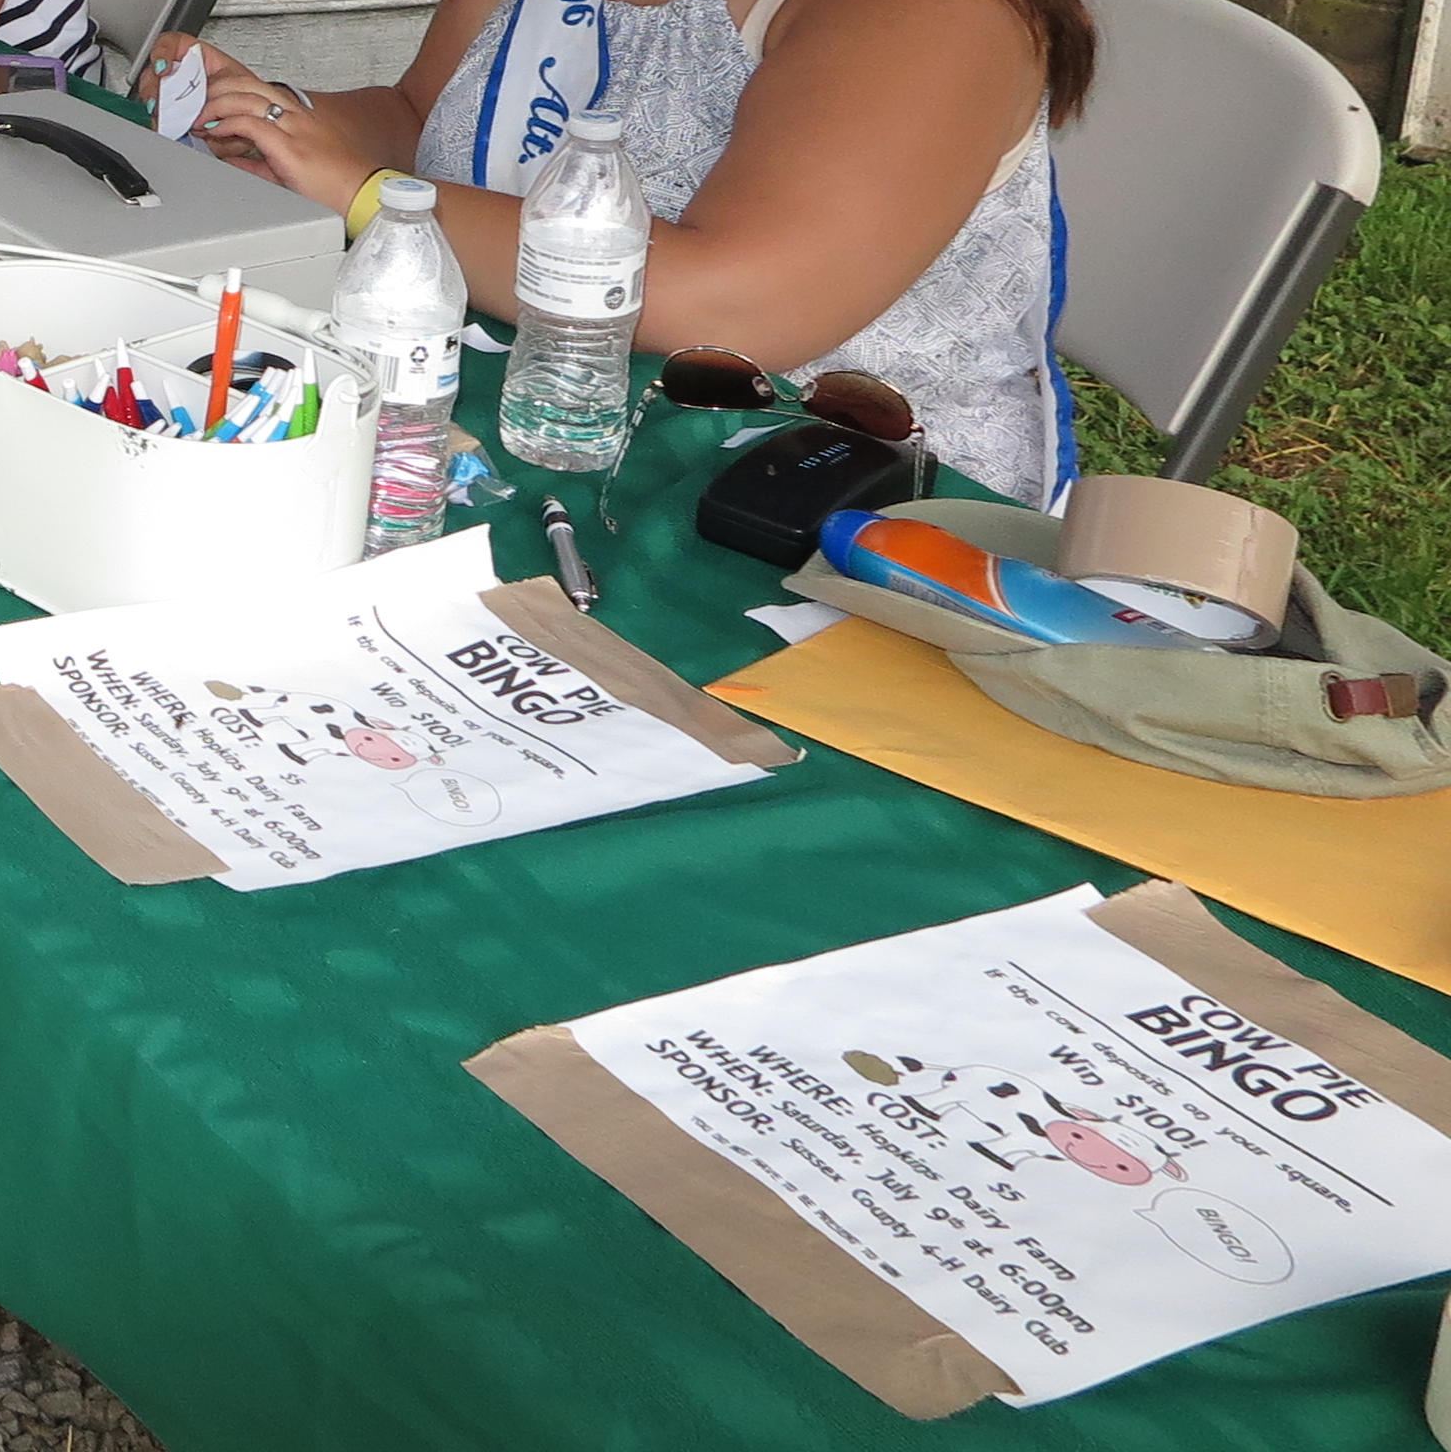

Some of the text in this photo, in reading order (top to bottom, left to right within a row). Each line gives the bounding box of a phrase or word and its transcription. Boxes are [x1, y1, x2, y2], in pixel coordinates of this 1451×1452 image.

[52, 655, 130, 738] SPONSOR:
[86, 648, 140, 710] WHEN:
[370, 681, 472, 748] Win $100!
[445, 639, 586, 725] BINGO
[495, 634, 627, 717] COW PIE
[194, 727, 246, 772] Hopkins
[244, 775, 285, 803] Dairy
[209, 706, 263, 748] COST:
[440, 778, 474, 813] BINGO!
[1124, 1003, 1339, 1122] BINGO
[1180, 994, 1386, 1110] COW PIE
[1006, 983, 1039, 1007] the
[1044, 1009, 1088, 1036] cow
[1092, 1041, 1174, 1097] deposits
[1182, 1102, 1212, 1121] on
[1215, 1125, 1272, 1158] your
[1275, 1161, 1354, 1214] square.
[1047, 1044, 1208, 1151] Win $100!
[644, 1039, 777, 1136] SPONSOR:
[780, 1137, 847, 1184] Sussex
[851, 1188, 917, 1240] County
[918, 1243, 967, 1272] 4-H
[962, 1273, 1020, 1316] Dairy
[685, 1029, 775, 1097] WHEN:
[866, 1167, 921, 1202] July
[963, 1238, 995, 1259] at
[997, 1262, 1096, 1334] 6:00pm
[747, 1044, 1077, 1281] WHERE: Hopkins Dairy Farm
[867, 1092, 1027, 1202] COST: $5
[1194, 1206, 1261, 1267] BINGO!
